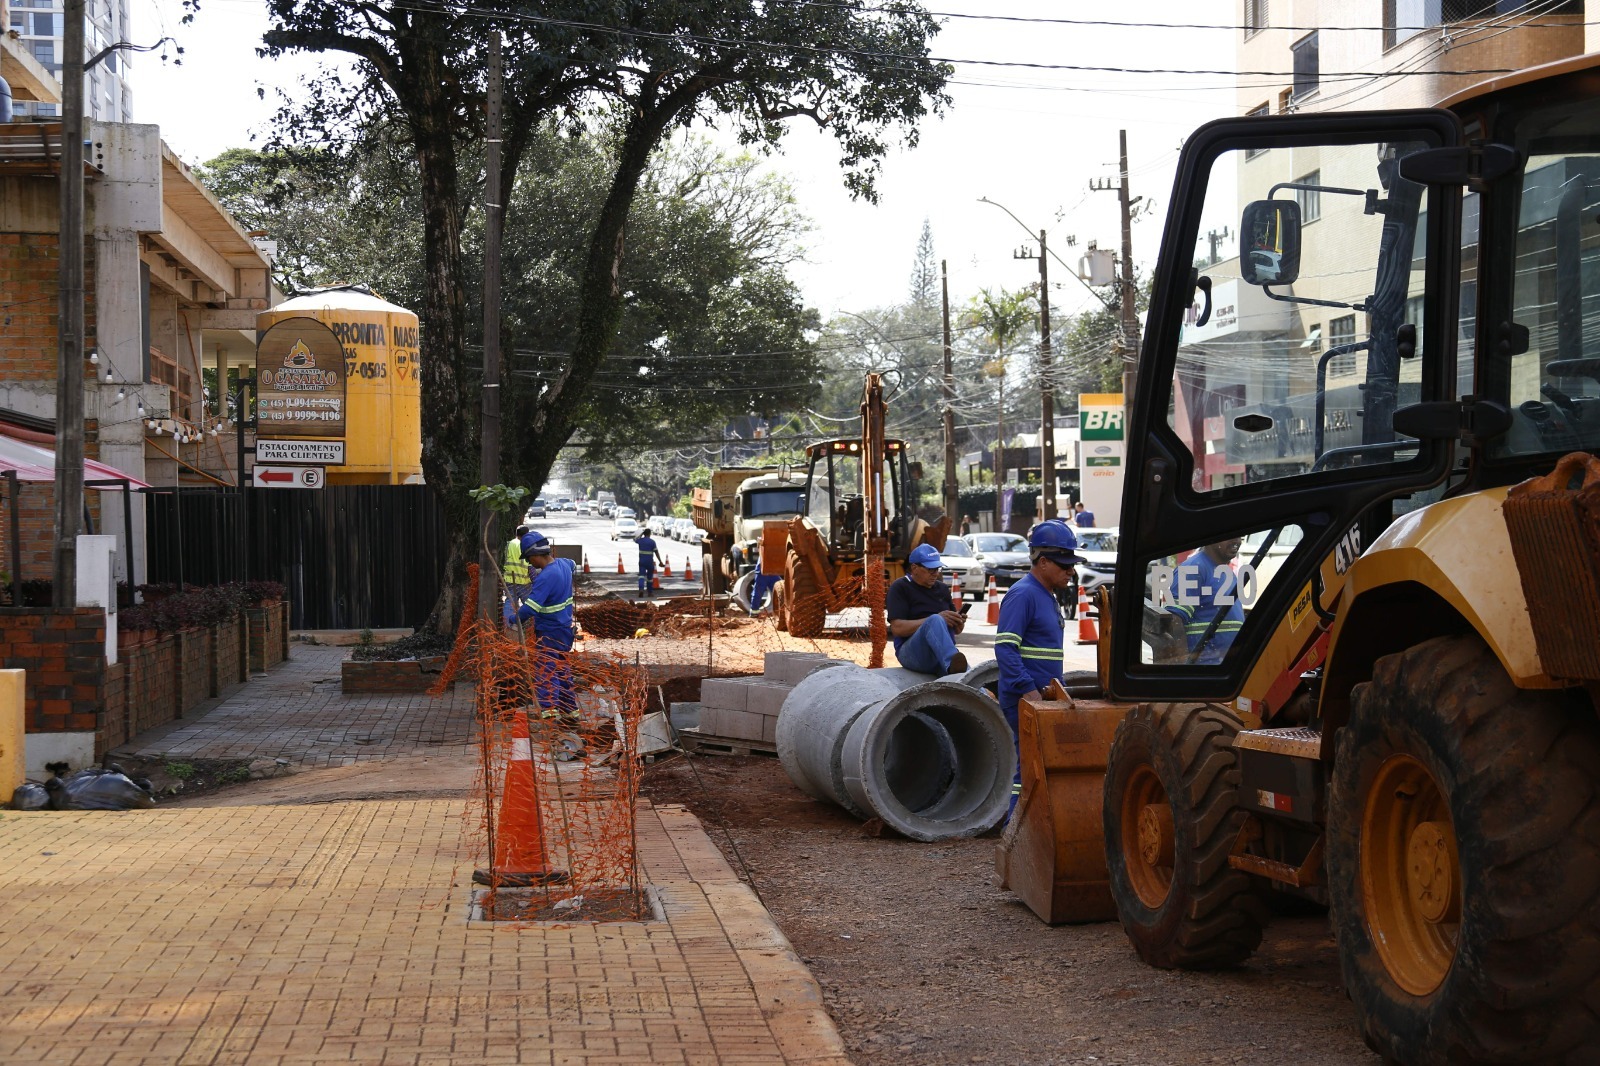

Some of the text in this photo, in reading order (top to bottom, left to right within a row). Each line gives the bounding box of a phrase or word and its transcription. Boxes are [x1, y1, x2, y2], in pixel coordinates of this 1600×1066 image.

[332, 322, 386, 345] PRONTA
[344, 347, 357, 359] SAS
[262, 369, 273, 385] O
[278, 367, 321, 375] RESTAURANTE
[270, 399, 284, 408] (45)
[271, 411, 340, 421] (45) 9 9999-4196
[1084, 410, 1123, 430] BR
[259, 443, 341, 452] ESTACIONAMENTO
[265, 451, 335, 460] PARA CLIENTES
[305, 472, 315, 483] E
[1335, 522, 1361, 574] 416
[1151, 564, 1257, 606] RE-20
[1293, 590, 1311, 621] PESA
